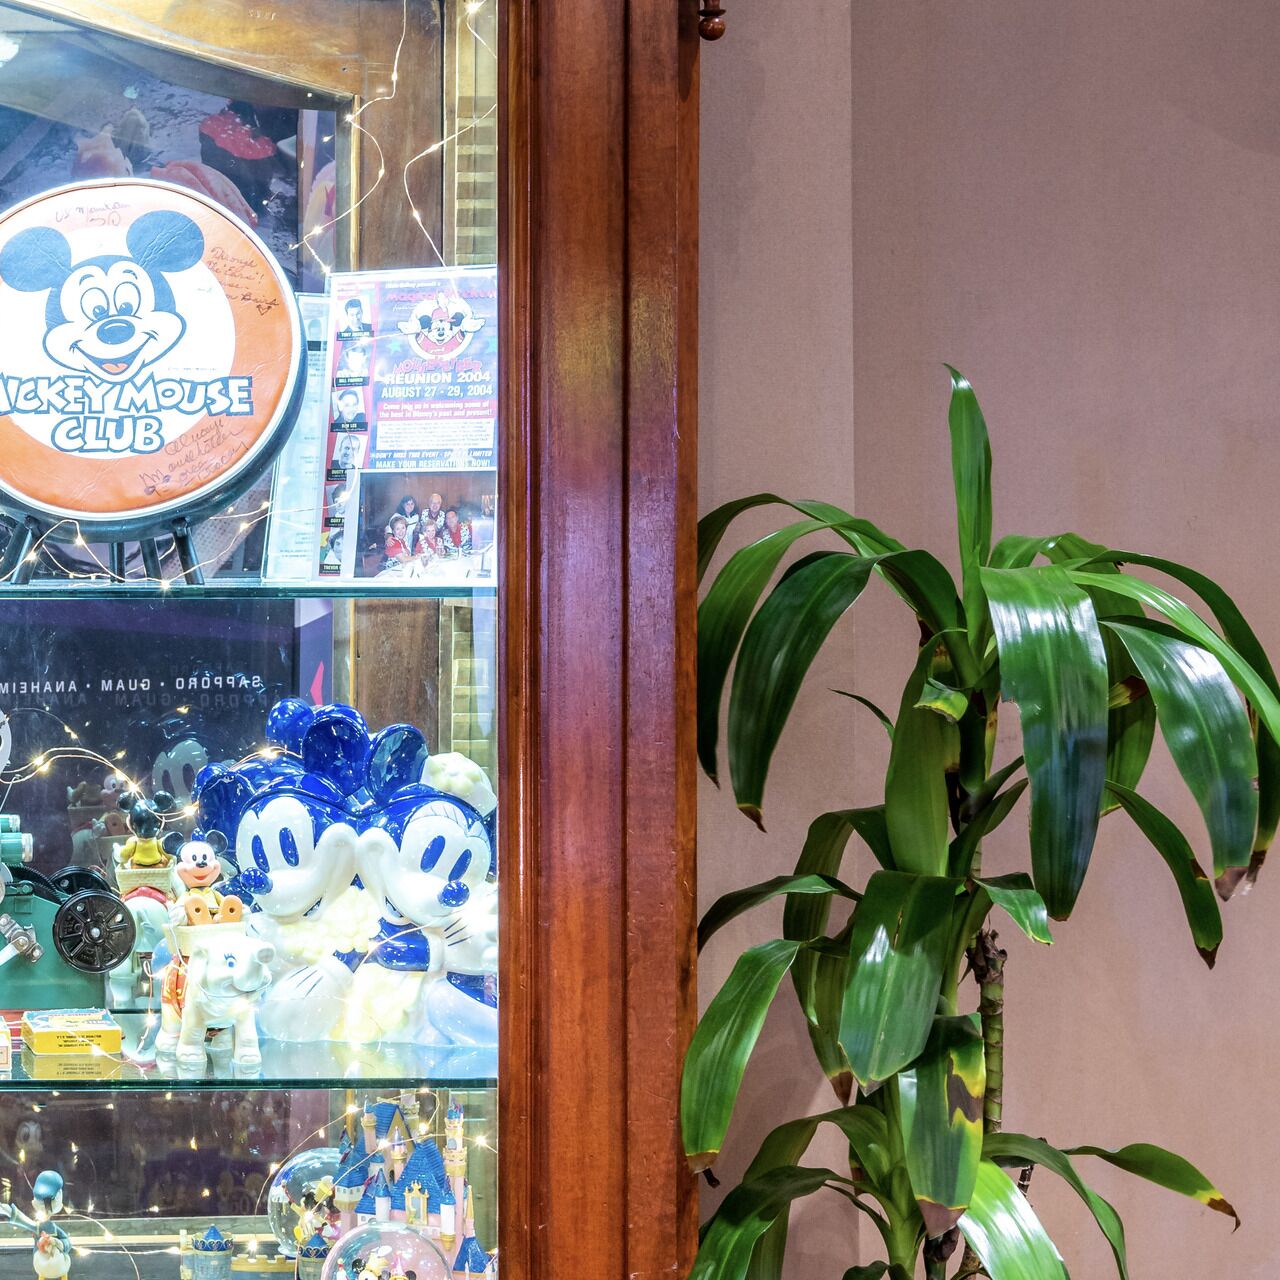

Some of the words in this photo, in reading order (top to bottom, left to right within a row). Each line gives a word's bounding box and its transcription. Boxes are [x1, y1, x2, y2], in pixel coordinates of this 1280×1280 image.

[383, 372, 452, 385] REUNION
[457, 371, 492, 384] 2004
[115, 371, 254, 417] MOUSE
[381, 387, 421, 399] AUGUST
[424, 386, 436, 398] 27
[448, 385, 463, 398] 29,
[469, 384, 494, 396] 2004
[51, 415, 165, 454] CLUB
[376, 460, 396, 468] MAKE
[399, 460, 417, 468] YOUR
